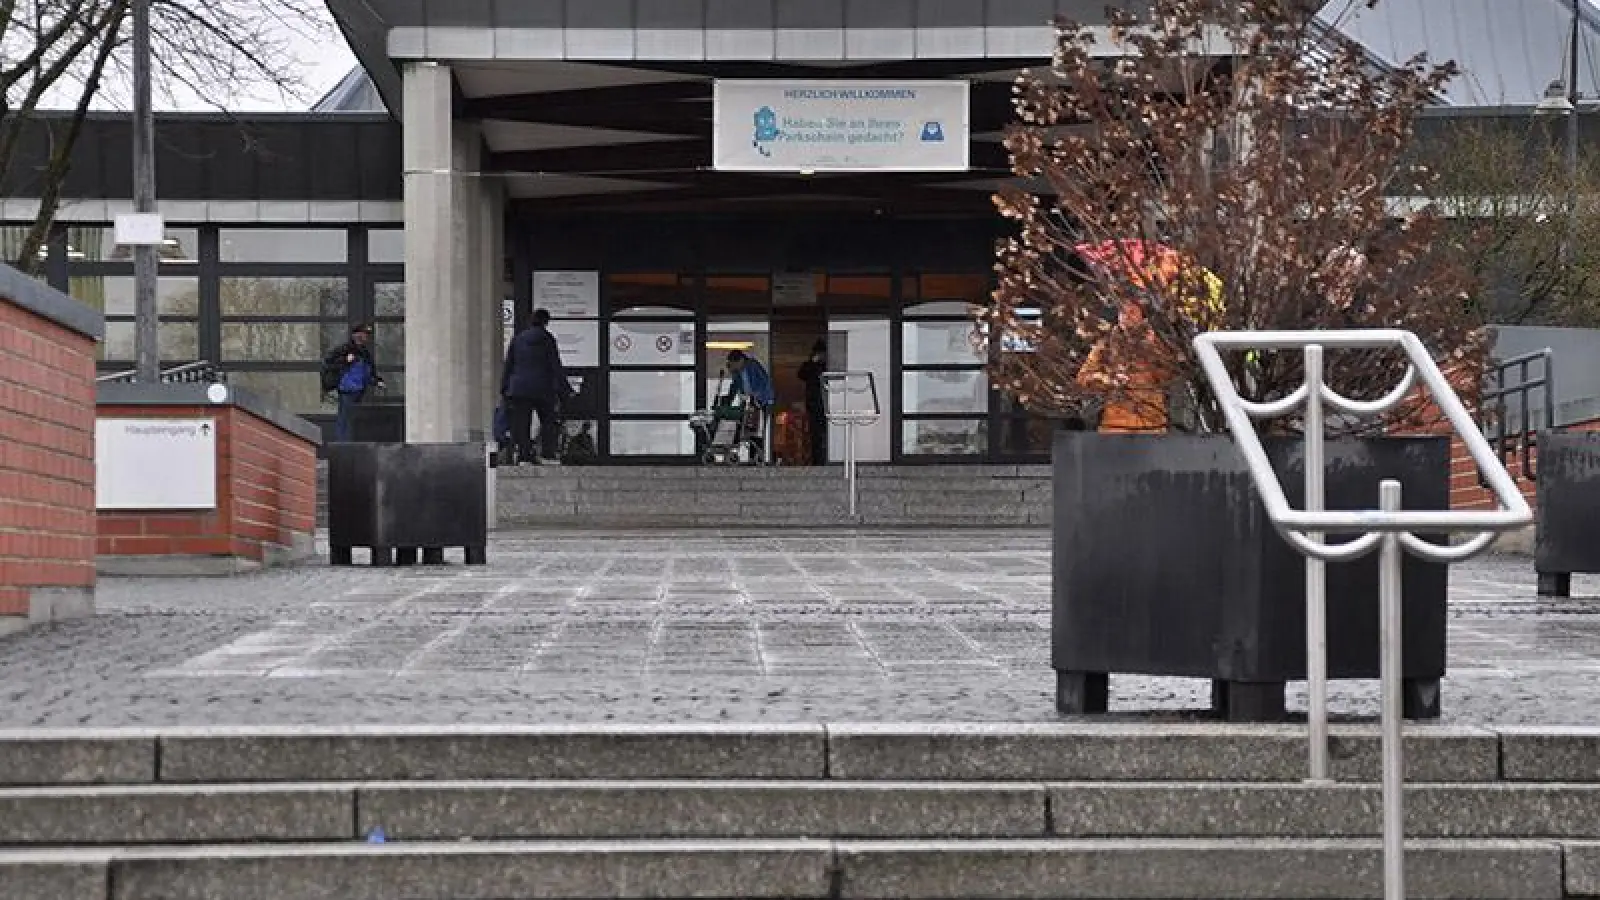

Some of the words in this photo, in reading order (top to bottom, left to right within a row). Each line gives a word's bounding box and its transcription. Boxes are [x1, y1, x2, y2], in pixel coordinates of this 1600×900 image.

[783, 89, 836, 99] HERZLICH
[838, 89, 917, 99] WILLKOMMEN
[783, 117, 823, 129] Haben
[826, 117, 847, 129] Sie
[850, 119, 865, 129] an
[847, 131, 905, 144] gedacht?
